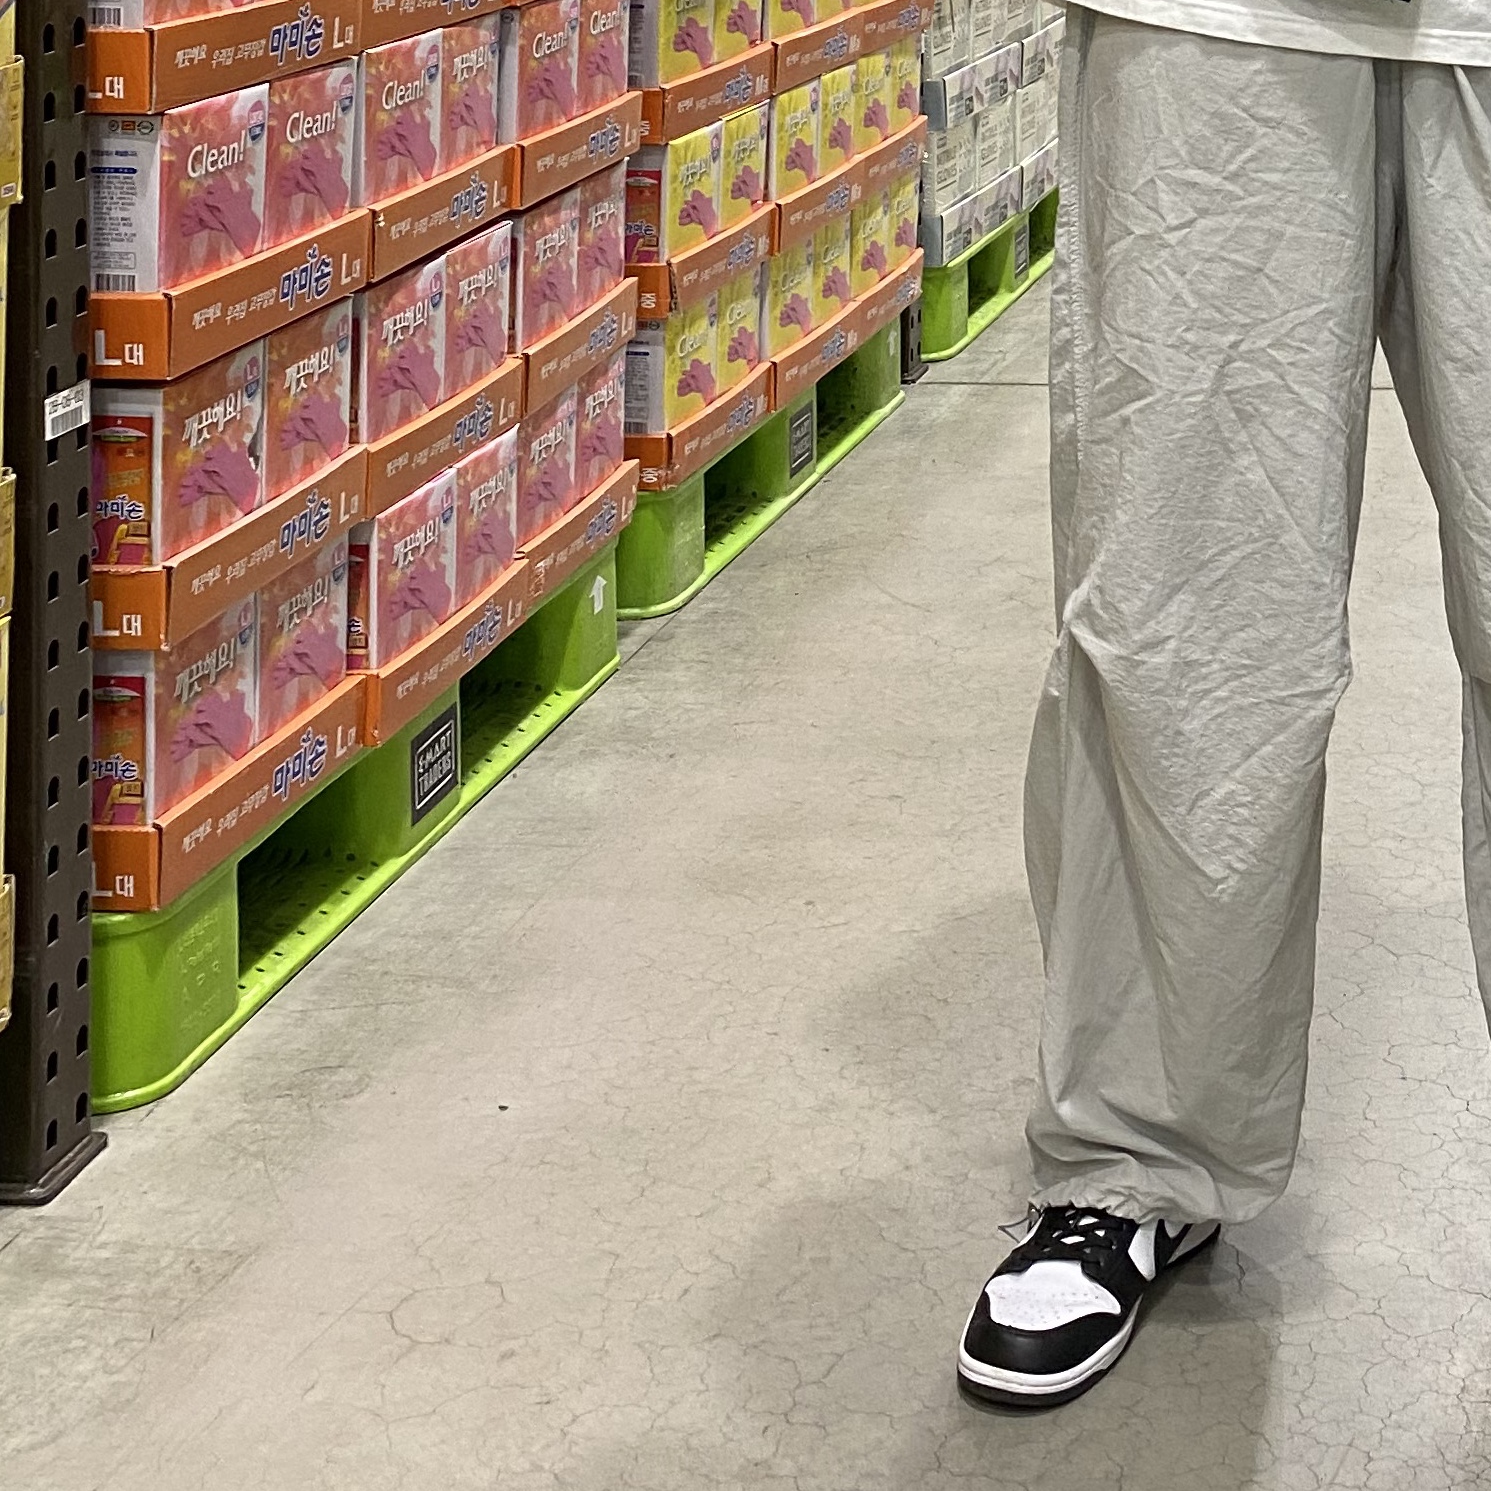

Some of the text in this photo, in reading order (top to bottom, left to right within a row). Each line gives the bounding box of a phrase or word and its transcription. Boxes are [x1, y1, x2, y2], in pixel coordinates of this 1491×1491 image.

[269, 15, 324, 65] 마미손
[533, 27, 567, 58] Clean!
[590, 8, 620, 35] Clean!
[89, 76, 124, 98] 대
[382, 70, 424, 111] Clean!
[286, 101, 338, 143] Clean!
[187, 130, 246, 177] Clean!
[450, 182, 487, 229] 마미손
[279, 254, 333, 310] 마미손
[381, 298, 428, 346] 깨끗해요!
[95, 330, 144, 365] L대
[283, 346, 334, 396] 깨끗해요!
[182, 390, 242, 448] 깨끗해요!
[453, 405, 493, 449] 마미손
[96, 499, 145, 521] 마미손
[279, 499, 331, 558] 마미손
[392, 519, 440, 568] 깨끗해요!
[93, 600, 142, 637] L대
[276, 575, 328, 628] 깨끗해요!
[462, 610, 501, 661] 마미손
[175, 638, 236, 703] 깨끗해요!
[271, 735, 327, 799] 마미손
